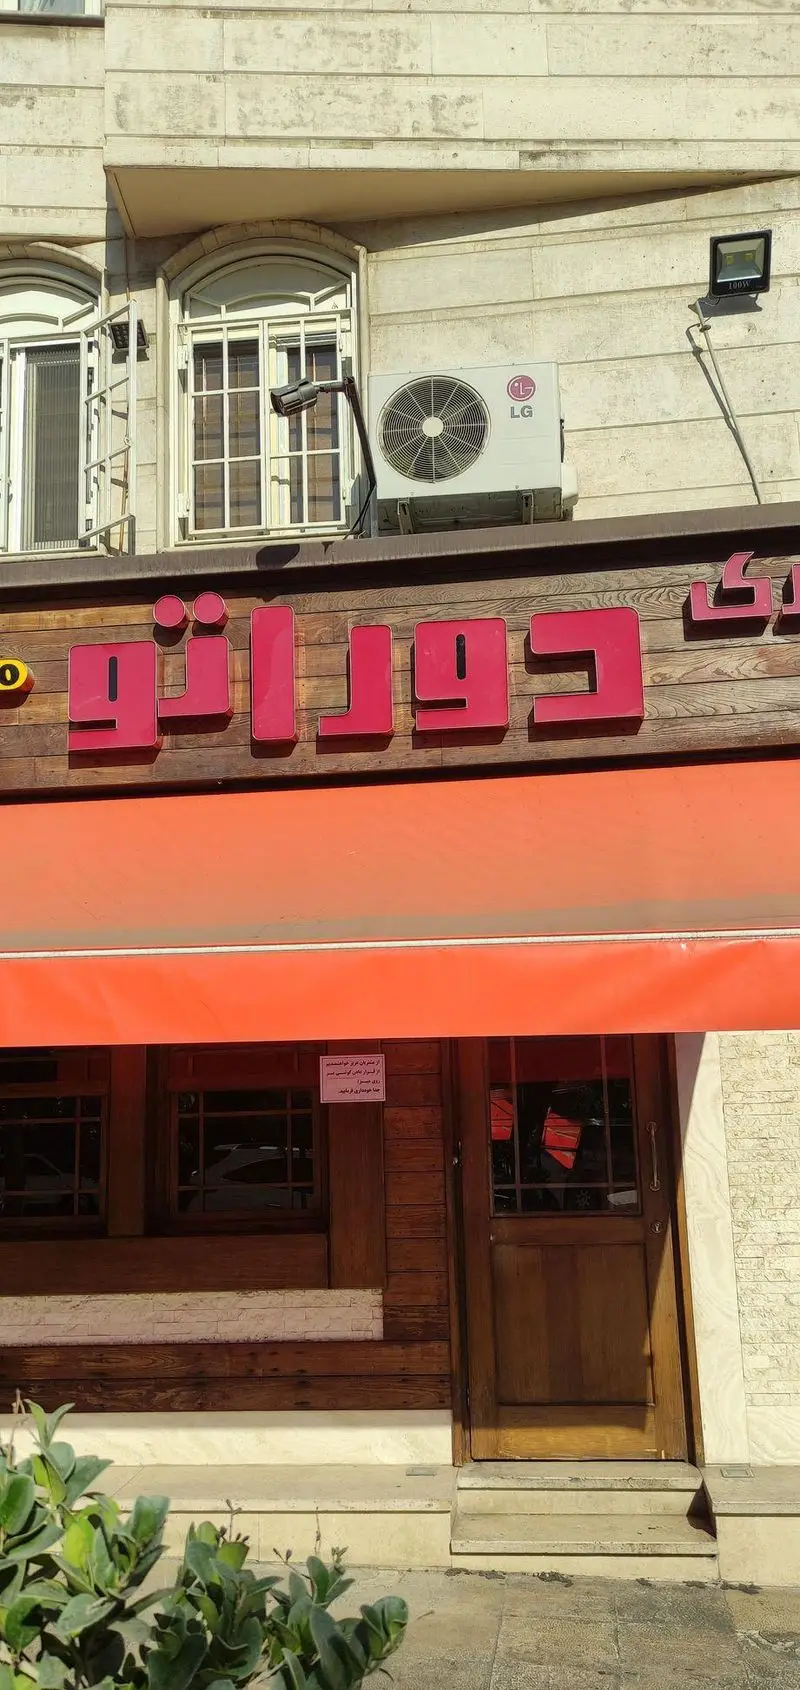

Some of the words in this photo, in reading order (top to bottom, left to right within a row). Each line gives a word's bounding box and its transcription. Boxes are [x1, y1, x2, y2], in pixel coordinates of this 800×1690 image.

[728, 280, 751, 290] 100W
[510, 405, 533, 419] LG
[68, 591, 645, 752] دوراتو
